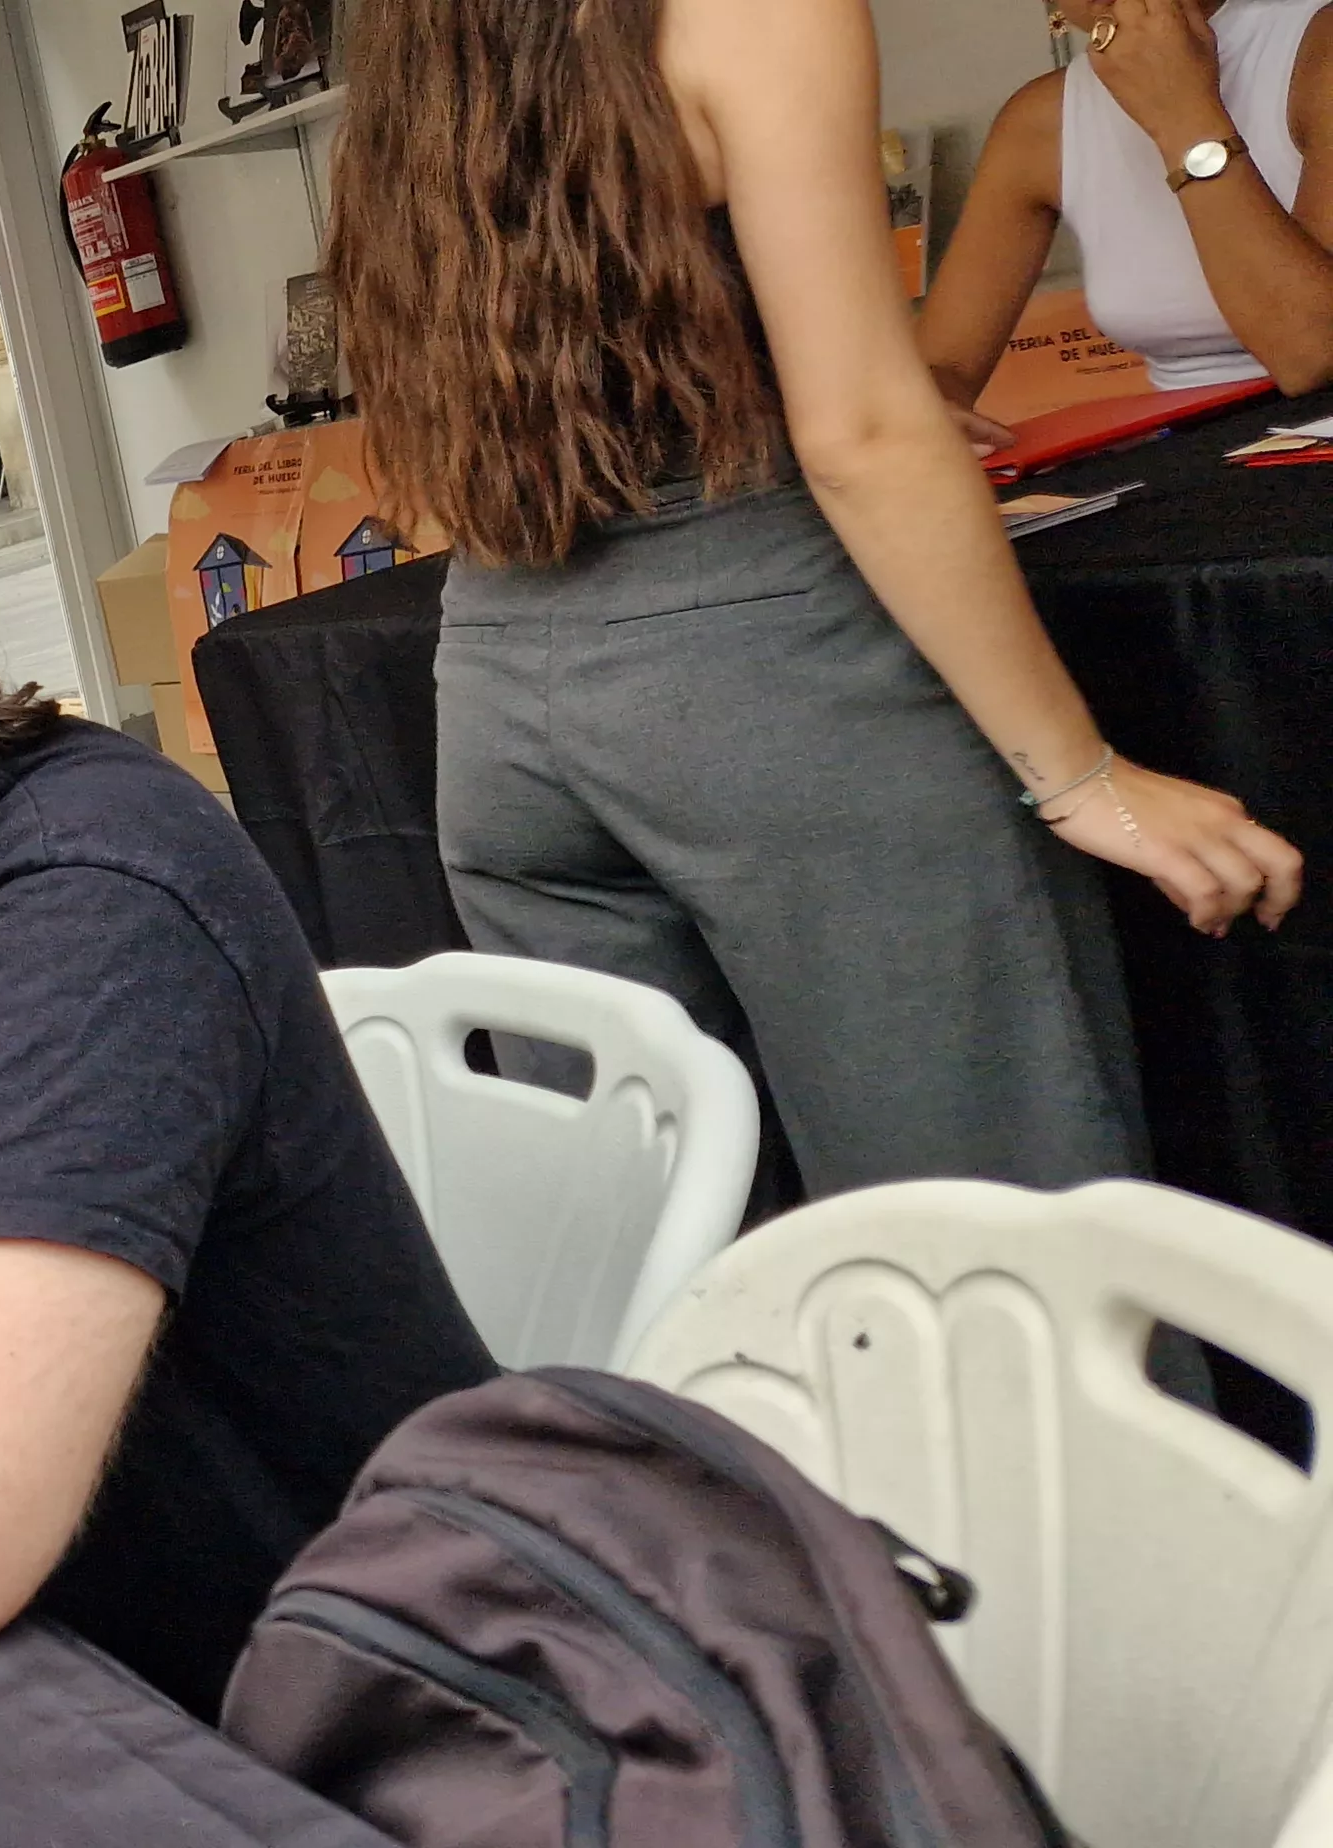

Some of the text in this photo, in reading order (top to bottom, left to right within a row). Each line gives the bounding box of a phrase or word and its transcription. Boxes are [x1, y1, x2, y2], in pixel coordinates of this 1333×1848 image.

[1008, 335, 1055, 352] FERIA
[1059, 327, 1091, 343] DEL
[1059, 348, 1080, 362] DE
[276, 457, 303, 470] LIBRO
[253, 475, 265, 486] DE
